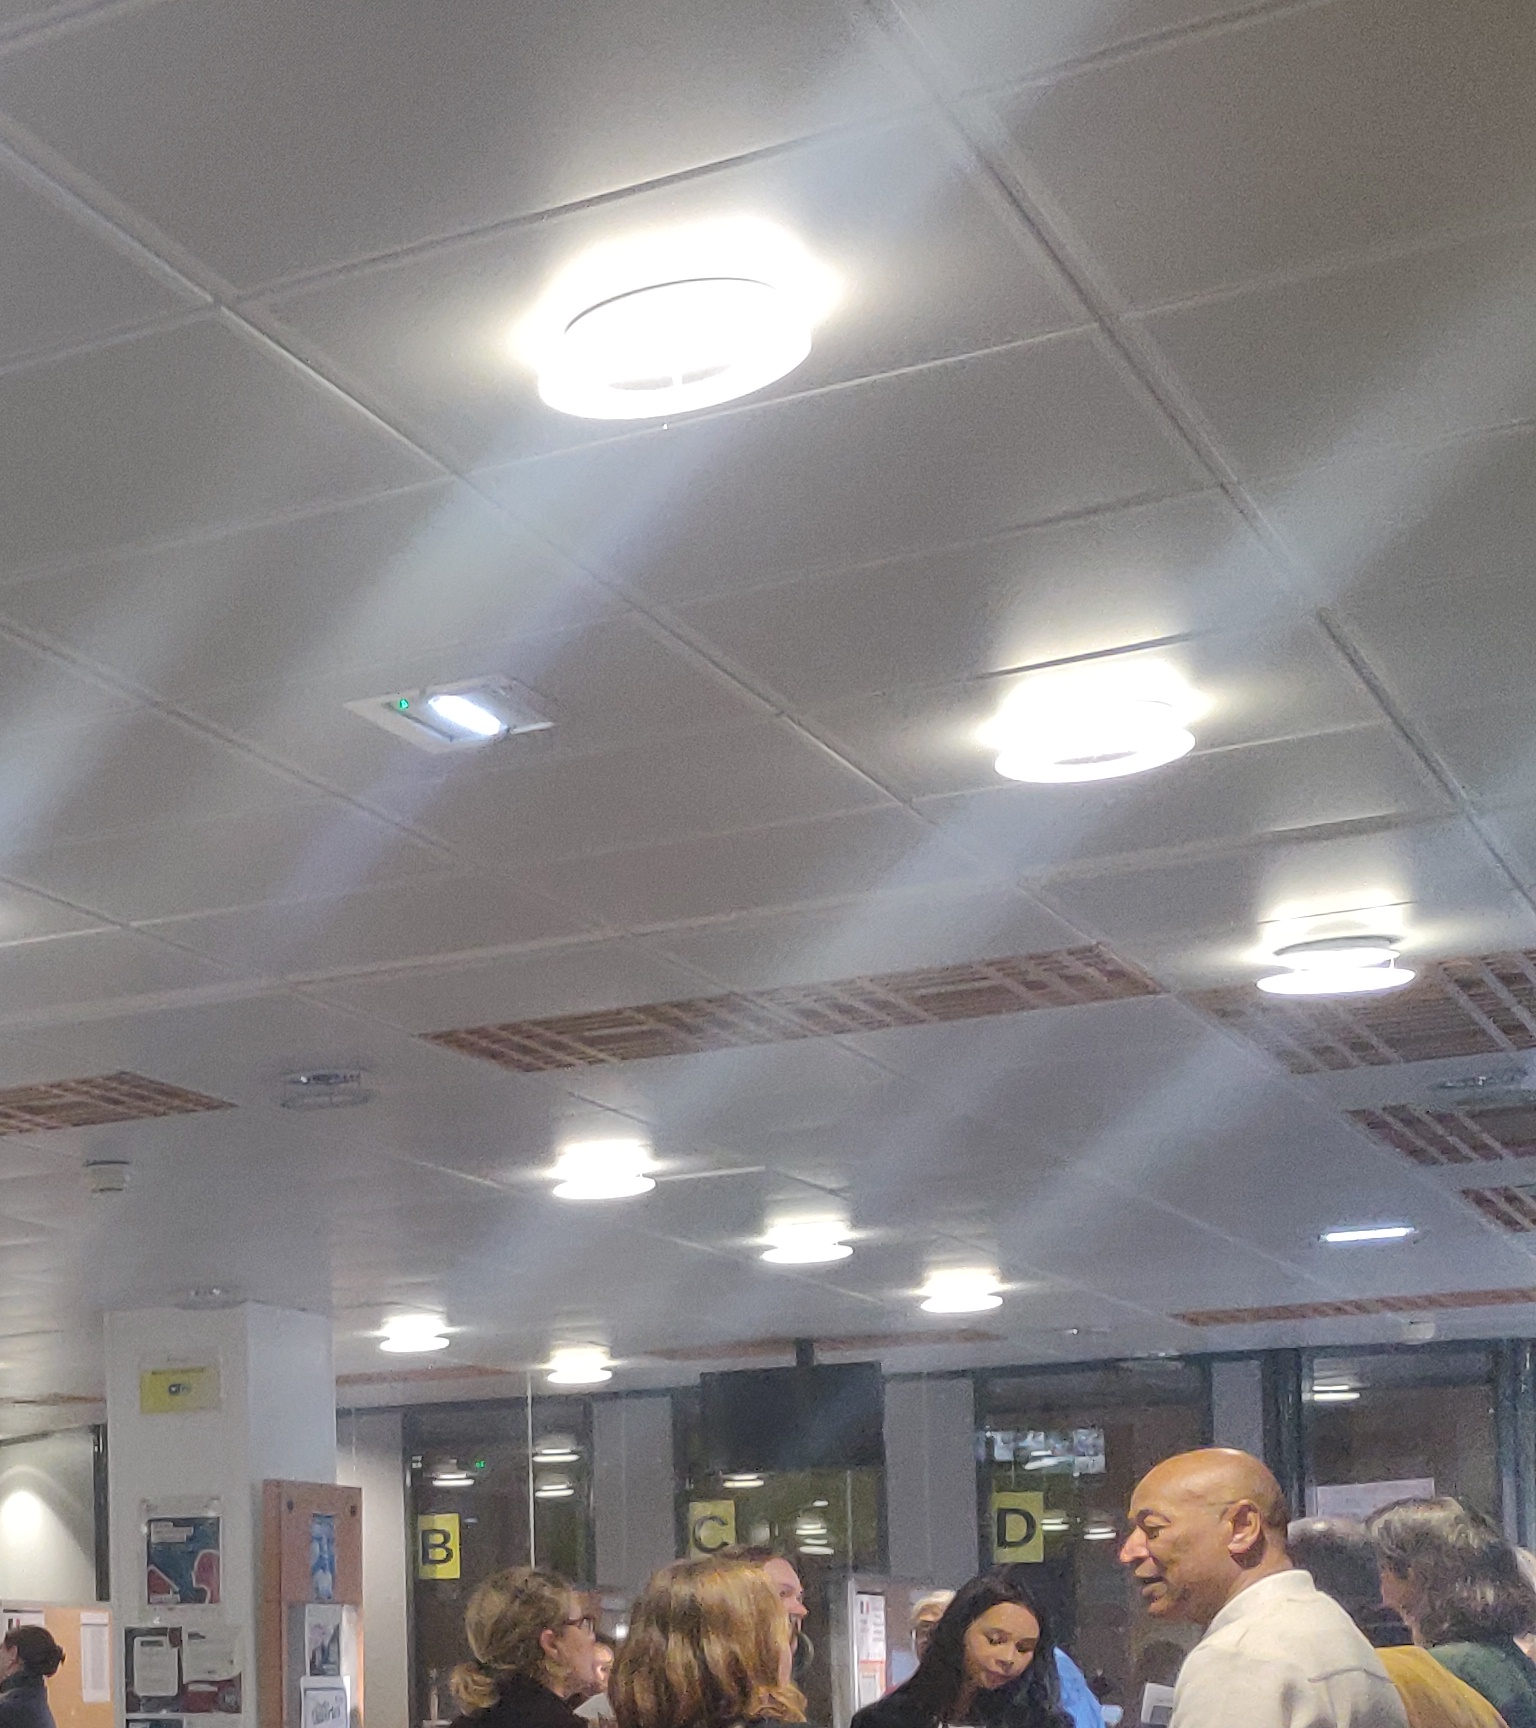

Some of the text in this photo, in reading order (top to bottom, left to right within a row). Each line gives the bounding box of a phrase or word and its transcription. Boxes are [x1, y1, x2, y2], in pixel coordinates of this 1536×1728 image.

[422, 1528, 454, 1565] B
[693, 1514, 730, 1554] C
[996, 1507, 1036, 1549] D
